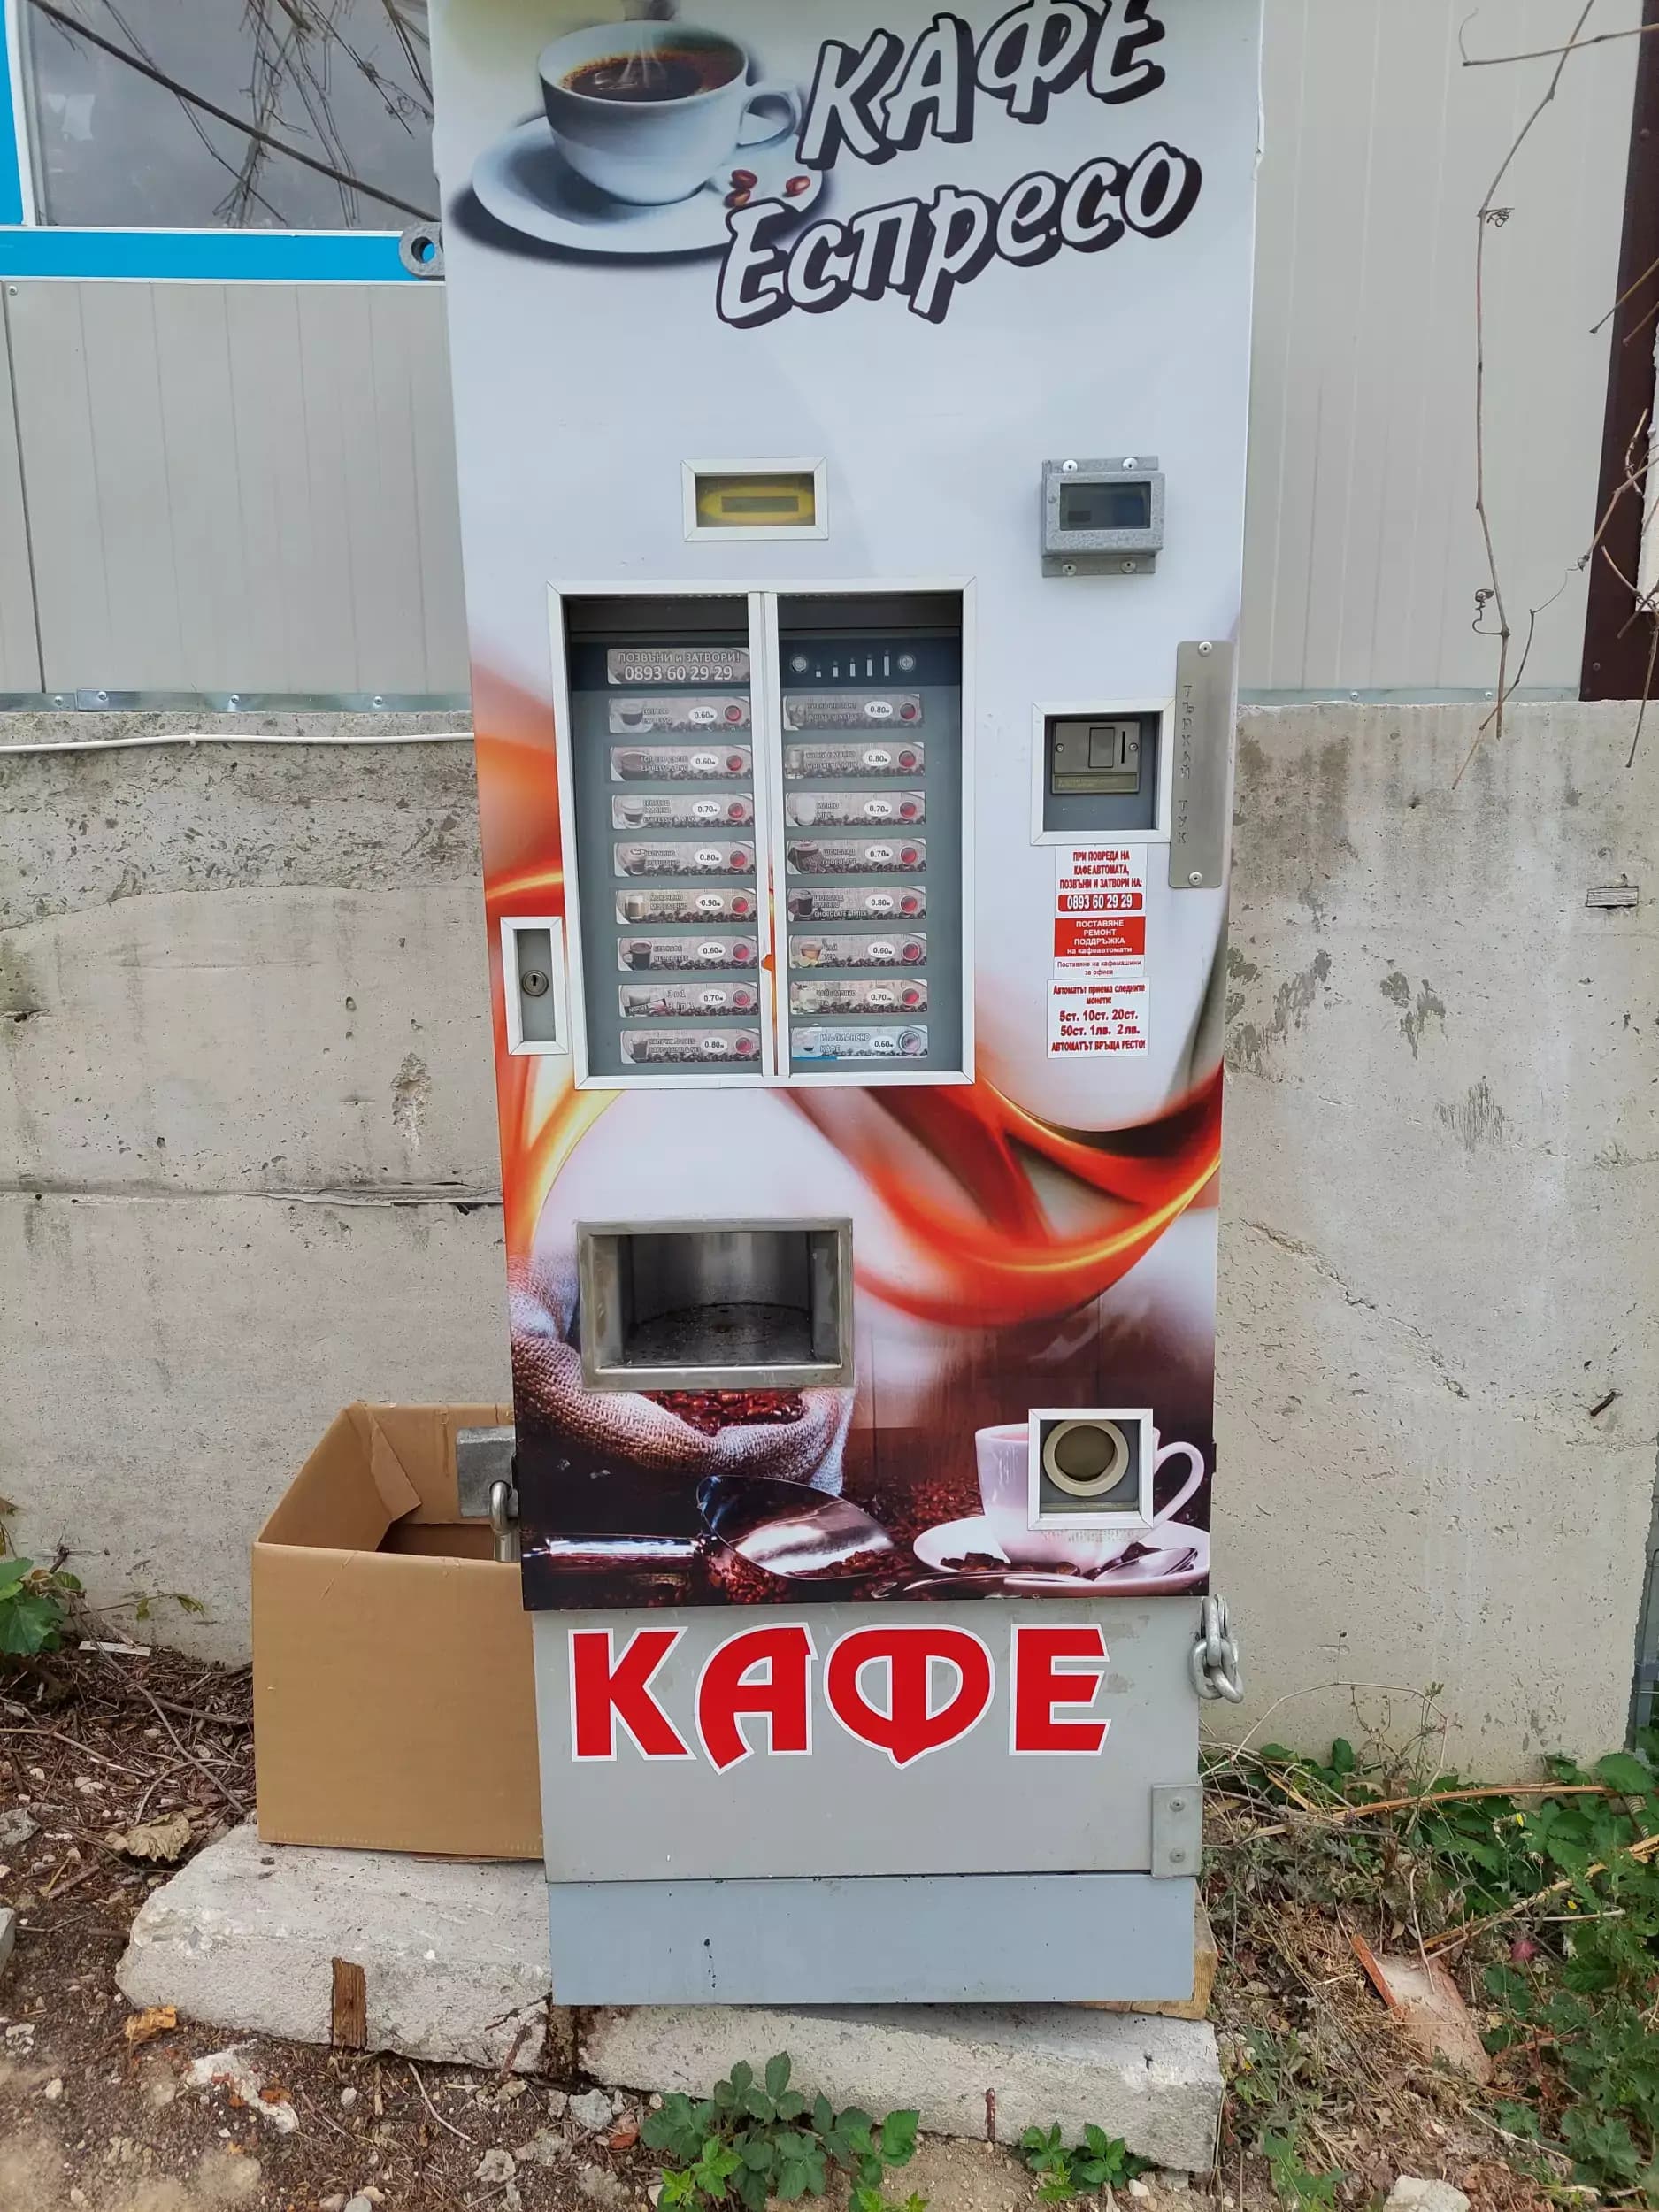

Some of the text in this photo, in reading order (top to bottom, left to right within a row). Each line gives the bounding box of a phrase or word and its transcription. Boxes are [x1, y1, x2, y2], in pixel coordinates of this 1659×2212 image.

[796, 0, 1165, 171] КАФЕ
[715, 139, 1203, 328] Еспресо
[618, 651, 673, 664] ПОЗВЪНИ
[686, 651, 741, 664] ЗАТВОРИ!
[625, 665, 733, 680] 0893 60 29 29
[1073, 850, 1130, 863] ПРИ ПОВРЕДА НА
[1060, 877, 1142, 889] ПОЗВЪНИ И ЗАТВОРИ НА:
[1067, 894, 1133, 910] 0893 60 29 29
[1076, 919, 1125, 928] ПОСТАВЯНЕ
[1074, 937, 1125, 946] ПОДДРЪЖКА
[1053, 985, 1087, 995] Автоматът
[1114, 984, 1146, 994] следните
[1059, 1009, 1139, 1022] 5ст. 10ст. 20ст.
[1060, 1025, 1087, 1037] 50ст.
[1090, 1025, 1111, 1035] 1лв.
[1051, 1041, 1093, 1053] АВТОМАТЪТ
[1094, 1040, 1120, 1052] ВРЪЩА
[567, 1620, 1113, 1776] КАФЕ
